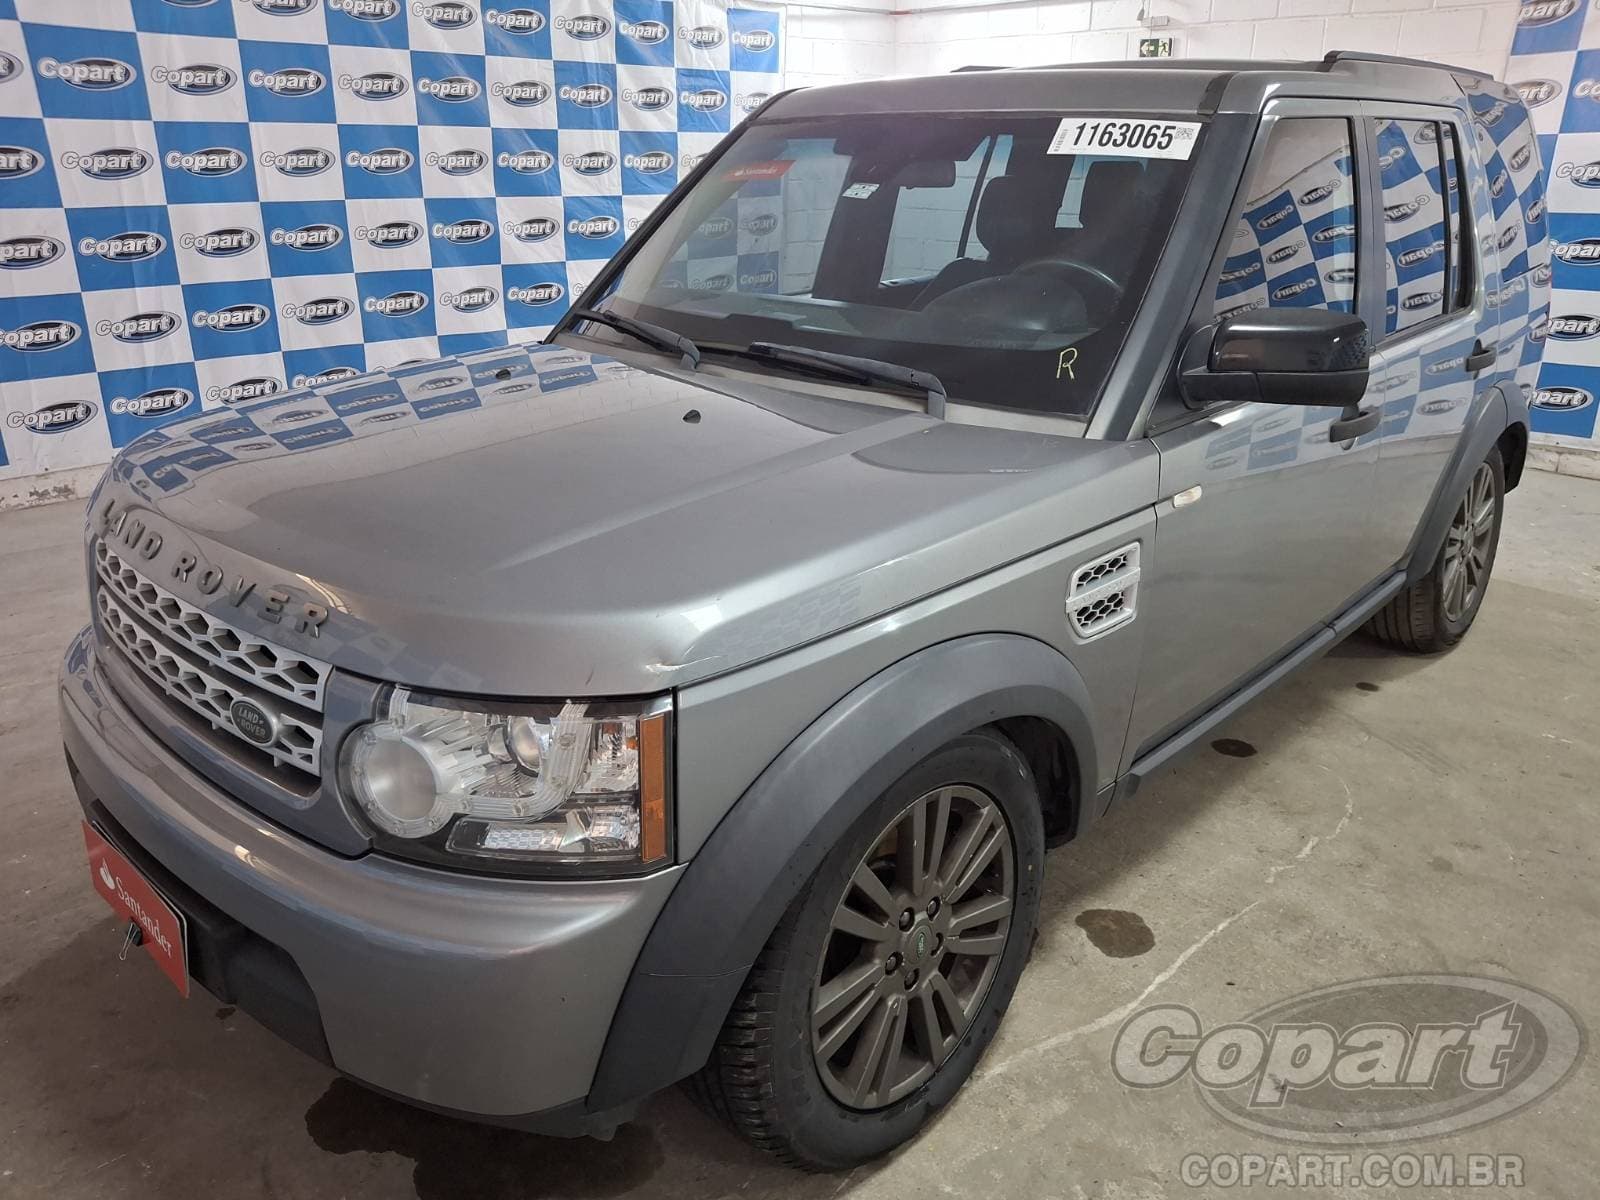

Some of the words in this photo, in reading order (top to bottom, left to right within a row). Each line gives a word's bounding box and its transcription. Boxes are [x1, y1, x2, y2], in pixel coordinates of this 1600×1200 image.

[413, 3, 470, 24] Copart
[486, 10, 541, 30] Copart
[1519, 0, 1569, 22] part
[554, 16, 603, 33] Copart
[618, 22, 664, 39] Copart
[678, 27, 722, 44] Copart
[732, 31, 773, 47] Copart
[38, 57, 127, 84] Copart
[151, 65, 226, 87] Copart
[249, 70, 319, 91] Copart
[339, 73, 400, 92] Copart
[417, 78, 475, 98] Copart
[491, 80, 544, 100] Copart
[559, 86, 607, 104] Copart
[622, 88, 668, 106] Copart
[680, 90, 722, 107] Copart
[734, 94, 763, 108] Copa
[1073, 121, 1177, 151] 1163065
[0, 150, 33, 171] art
[61, 150, 143, 173] Copart
[166, 150, 239, 171] Copart
[260, 151, 327, 170] Copart
[347, 151, 411, 170] Copart
[425, 152, 482, 170] Copart
[498, 152, 549, 169] Copart
[562, 152, 613, 169] Copart
[624, 154, 670, 169] Copart
[354, 221, 418, 243] Copart
[432, 221, 488, 240] Copart
[503, 219, 553, 238] Copart
[567, 217, 616, 236] Copart
[79, 236, 157, 260] Copart
[180, 231, 251, 253] Copart
[271, 228, 337, 248] Copart
[0, 240, 53, 262] part
[440, 288, 492, 310] Copart
[508, 283, 562, 304] Copart
[282, 299, 345, 322] Copart
[364, 295, 421, 316] Copart
[96, 315, 171, 339] Copart
[192, 306, 262, 330] Copart
[1548, 317, 1598, 336] part
[0, 322, 71, 348] opart
[1056, 347, 1078, 380] R
[206, 378, 274, 402] Copart
[1531, 389, 1586, 406] part
[111, 391, 184, 415] Copart
[7, 403, 87, 429] Copart
[102, 498, 163, 560] LAND
[171, 551, 329, 638] ROVER
[238, 706, 259, 724] LAND
[240, 719, 266, 737] ROVER
[115, 876, 172, 959] Santander
